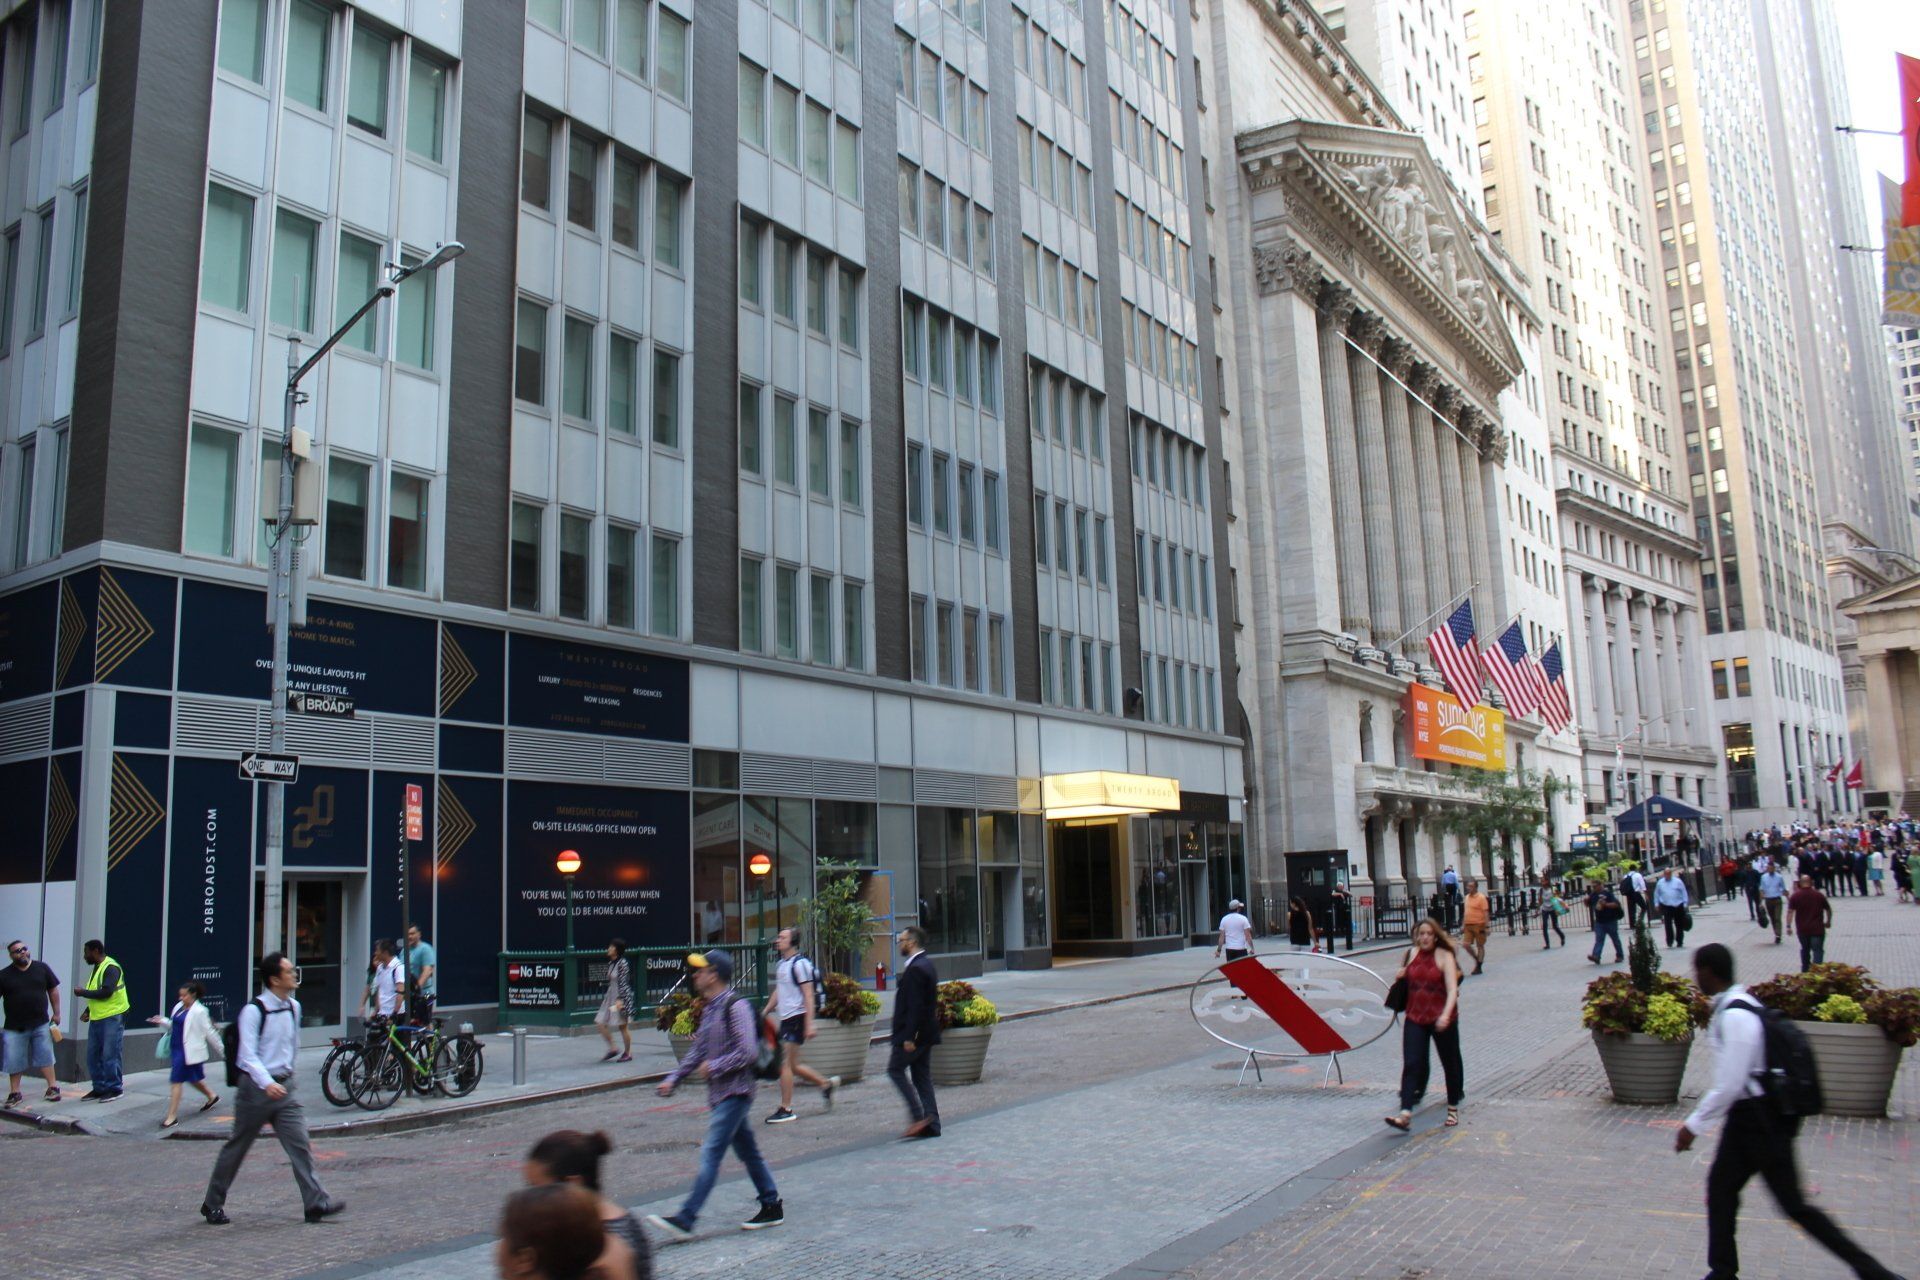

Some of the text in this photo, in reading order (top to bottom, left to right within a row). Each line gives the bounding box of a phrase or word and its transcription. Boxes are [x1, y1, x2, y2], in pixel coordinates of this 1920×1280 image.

[294, 631, 317, 641] HOME
[319, 633, 329, 642] TO
[560, 652, 648, 672] TWENTY BROAD
[256, 659, 274, 668] OVE
[293, 664, 321, 675] UNIQUE
[323, 668, 354, 679] LAYOUTS
[355, 672, 367, 681] FIT
[295, 681, 311, 690] ANY
[312, 683, 349, 695] LIFESTYLE.
[538, 675, 560, 684] LUXURY
[633, 688, 662, 698] RESIDENCES
[306, 698, 345, 713] BROAD
[584, 695, 620, 706] NOW LEASING
[247, 760, 292, 773] ONE WAY
[1112, 784, 1172, 798] TWENTY BROAD
[555, 806, 639, 819] IMMEDIATE OCCUPANCY
[532, 820, 657, 835] ON-SITE LEASING OFFICE NOW OPEN
[204, 808, 217, 934] 20BROADST.COM
[521, 890, 660, 900] YOU'RE WALING TO THE SUBWAY WHEN
[537, 906, 647, 916] YOU COLD BE HOME ALREADY.
[646, 957, 682, 970] Subway
[520, 965, 560, 980] No Entry
